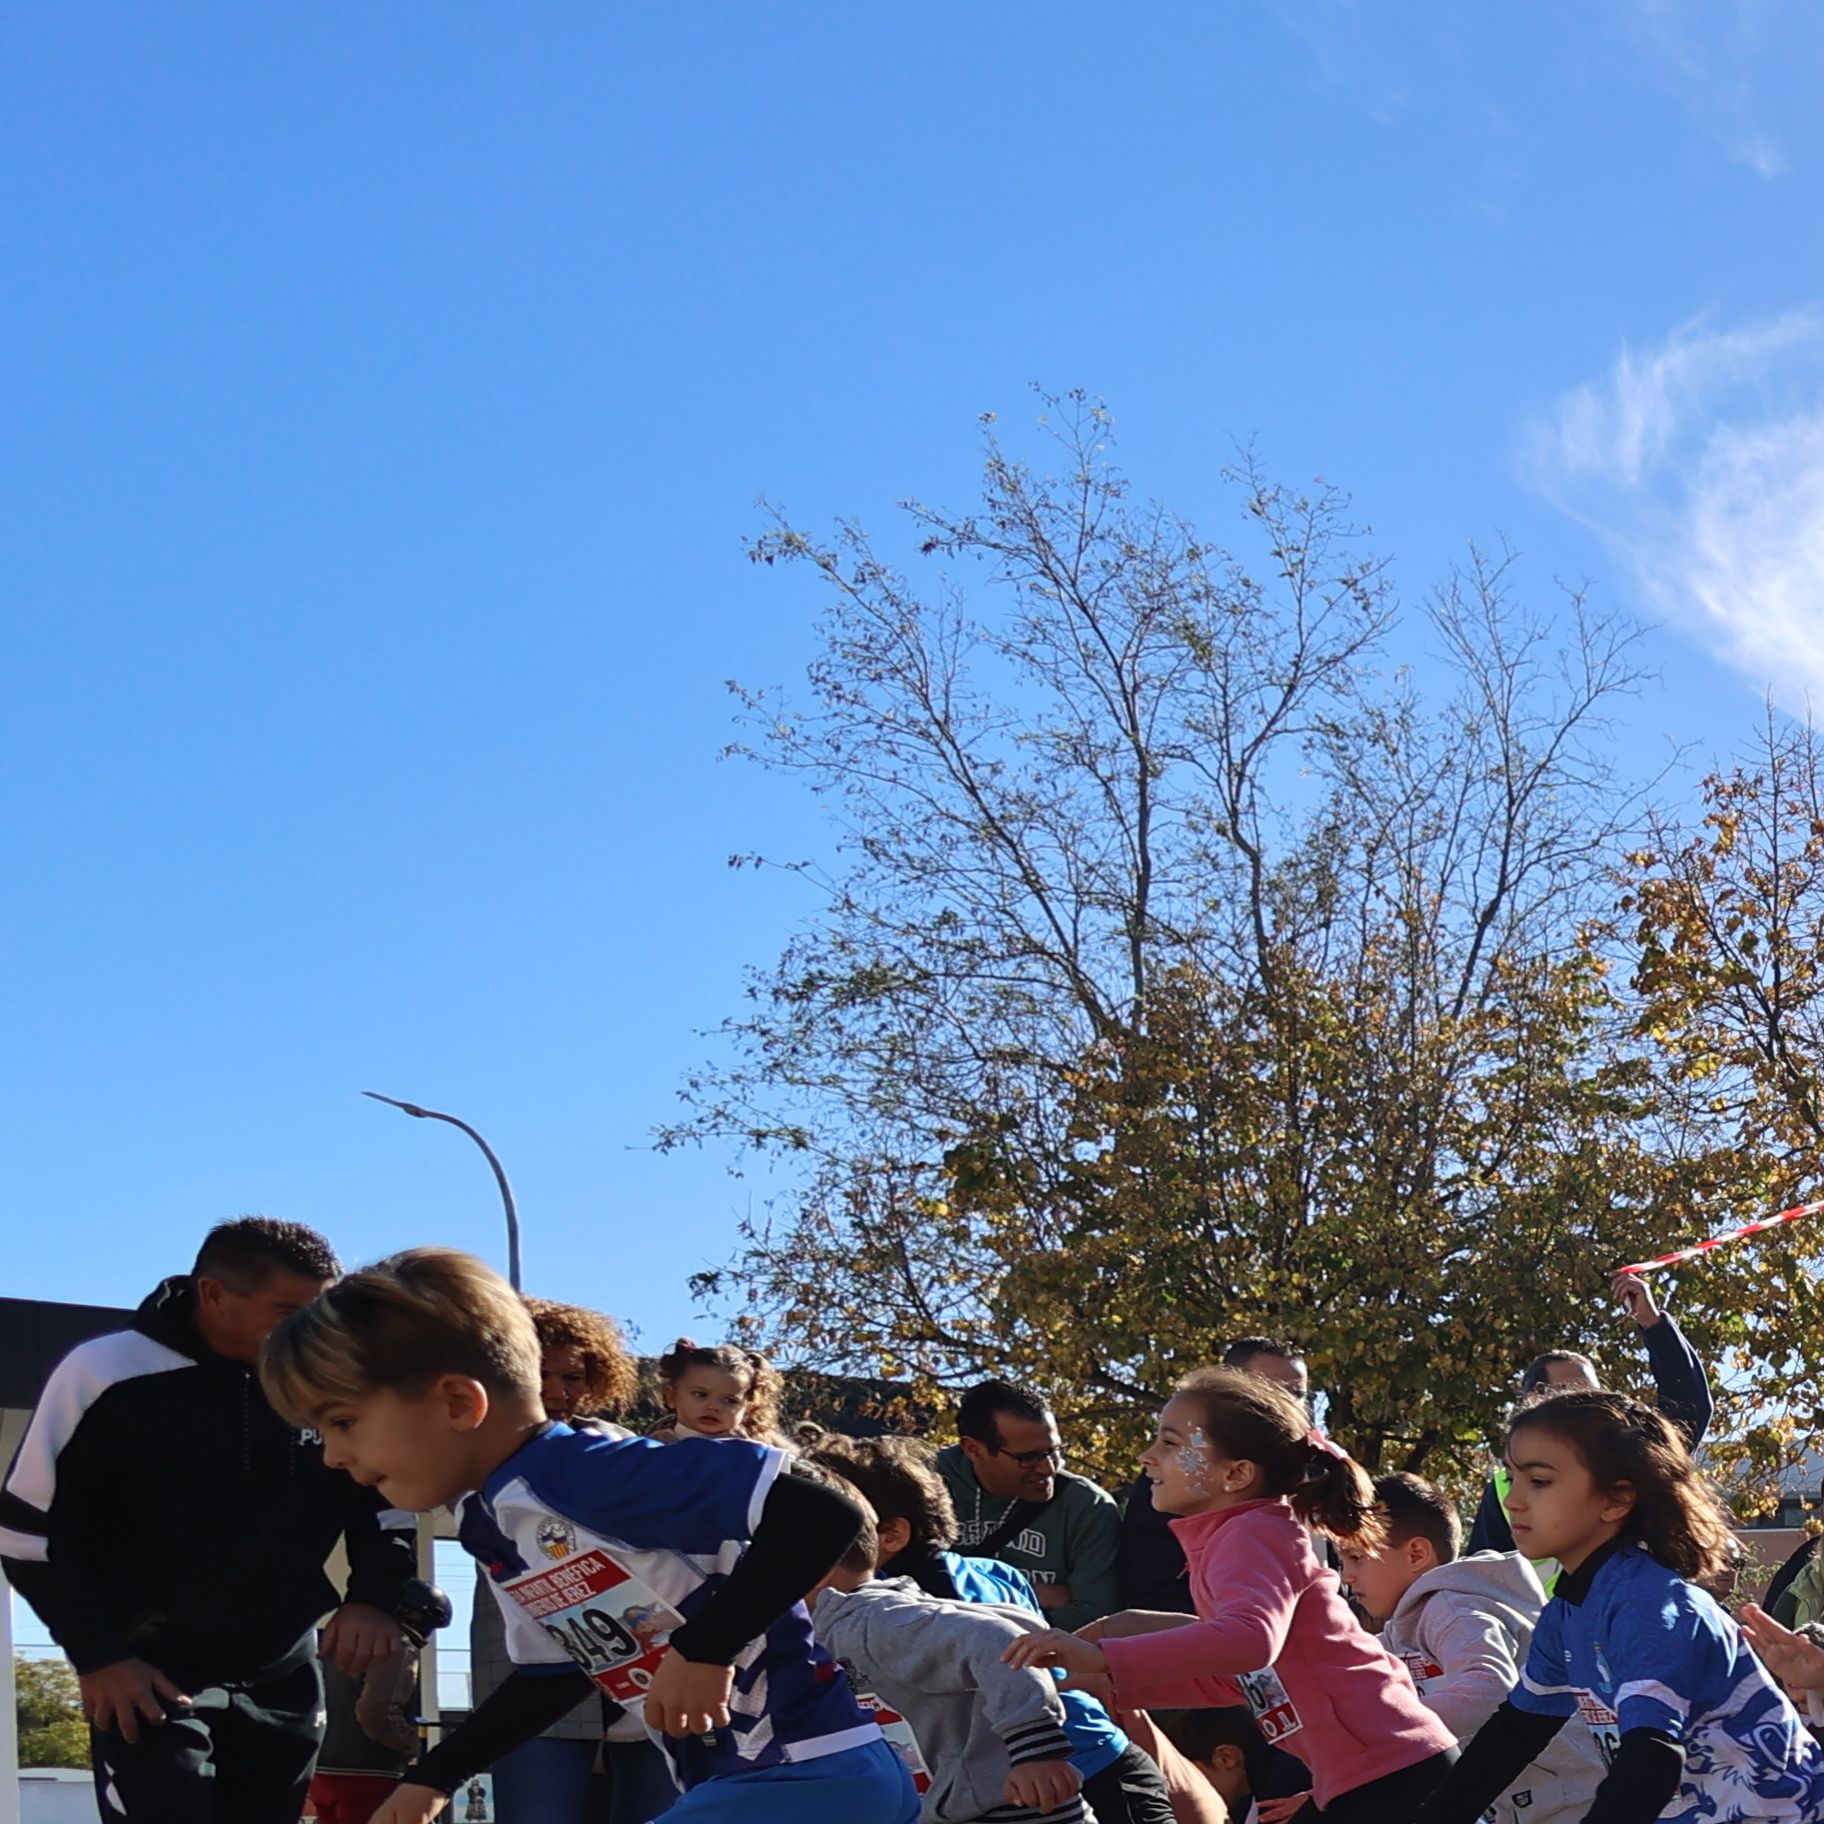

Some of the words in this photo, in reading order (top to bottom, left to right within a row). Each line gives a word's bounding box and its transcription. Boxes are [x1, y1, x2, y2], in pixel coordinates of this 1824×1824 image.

[300, 1428, 322, 1446] PU
[551, 1556, 606, 1590] BENÉFICA
[561, 1580, 597, 1608] JEREZ
